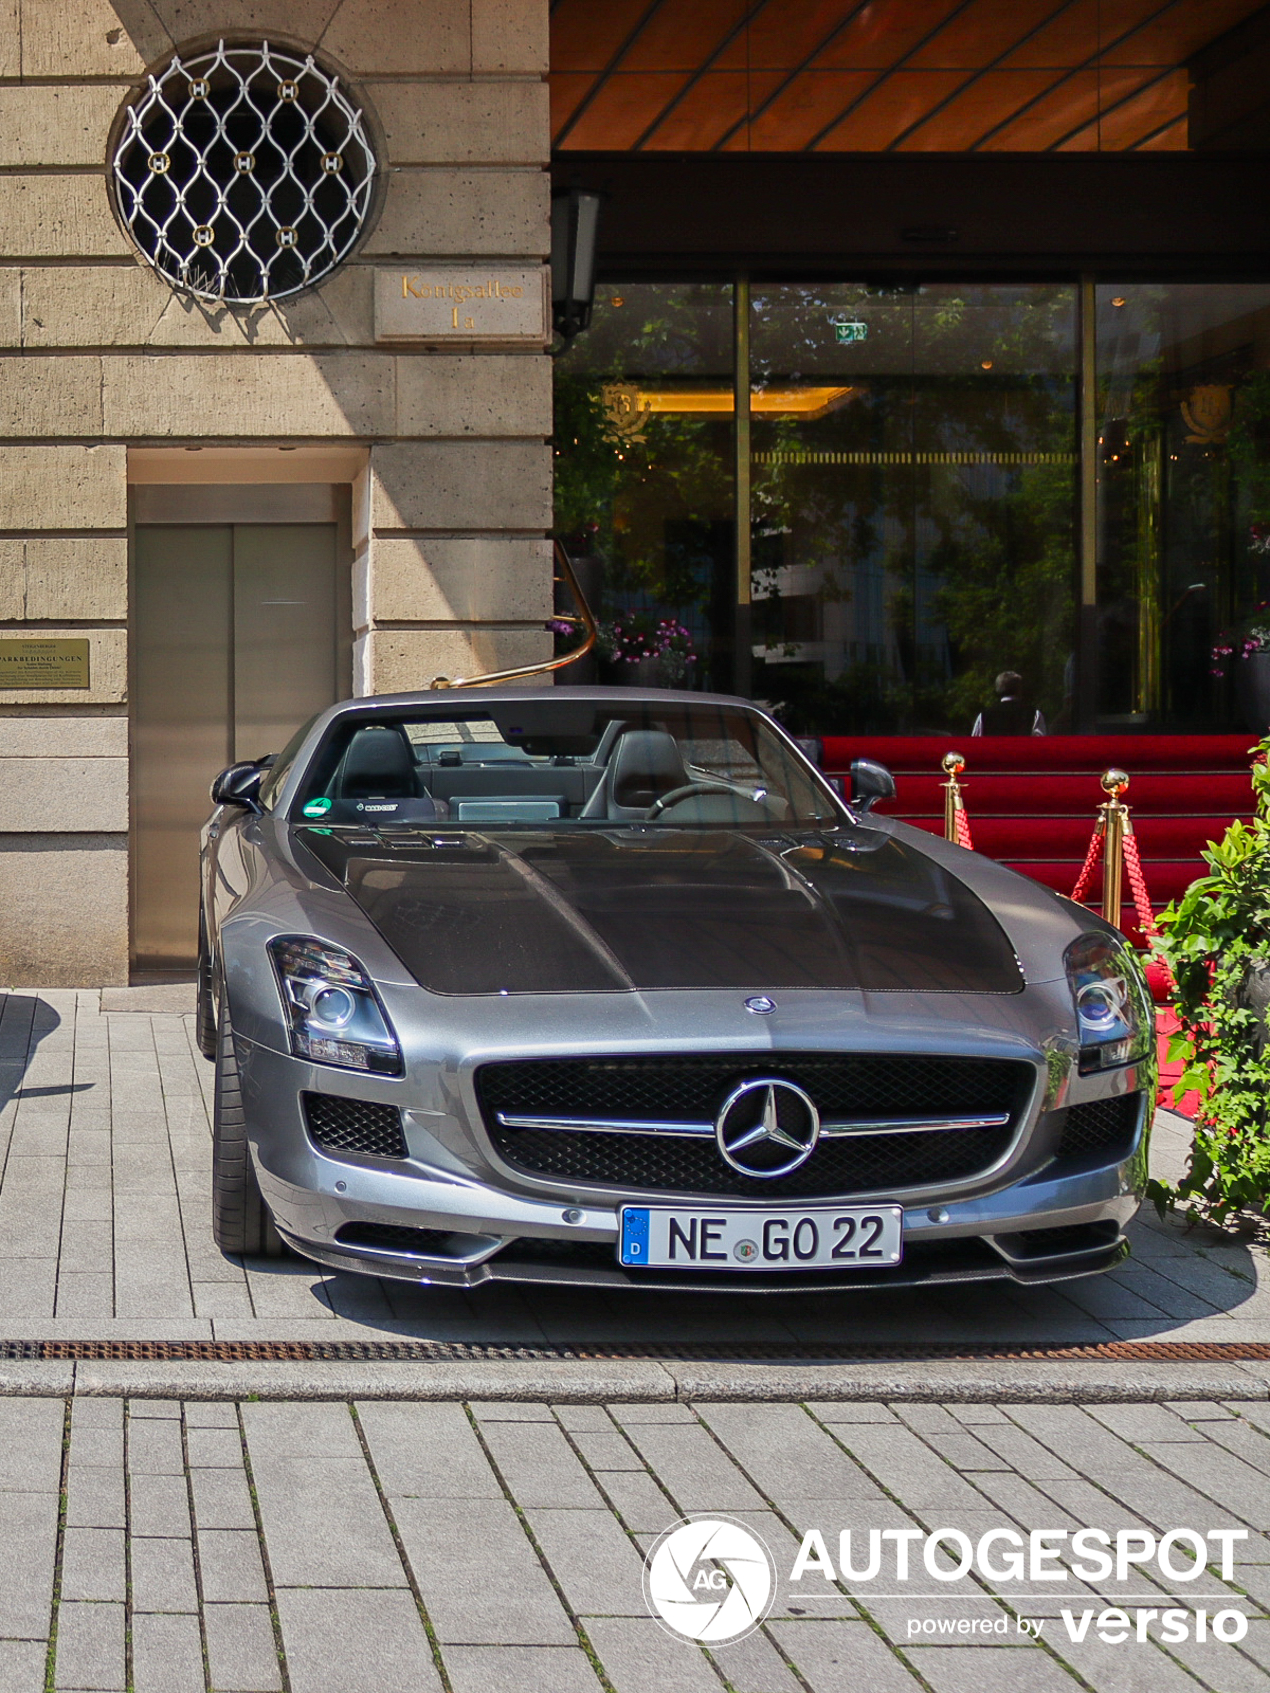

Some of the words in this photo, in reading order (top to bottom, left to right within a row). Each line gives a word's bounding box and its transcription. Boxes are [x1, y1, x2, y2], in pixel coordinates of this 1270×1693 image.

[401, 275, 523, 304] Königsallee
[630, 1242, 641, 1255] D
[668, 1217, 727, 1260] NE
[762, 1218, 819, 1261] GO
[831, 1215, 884, 1260] 22
